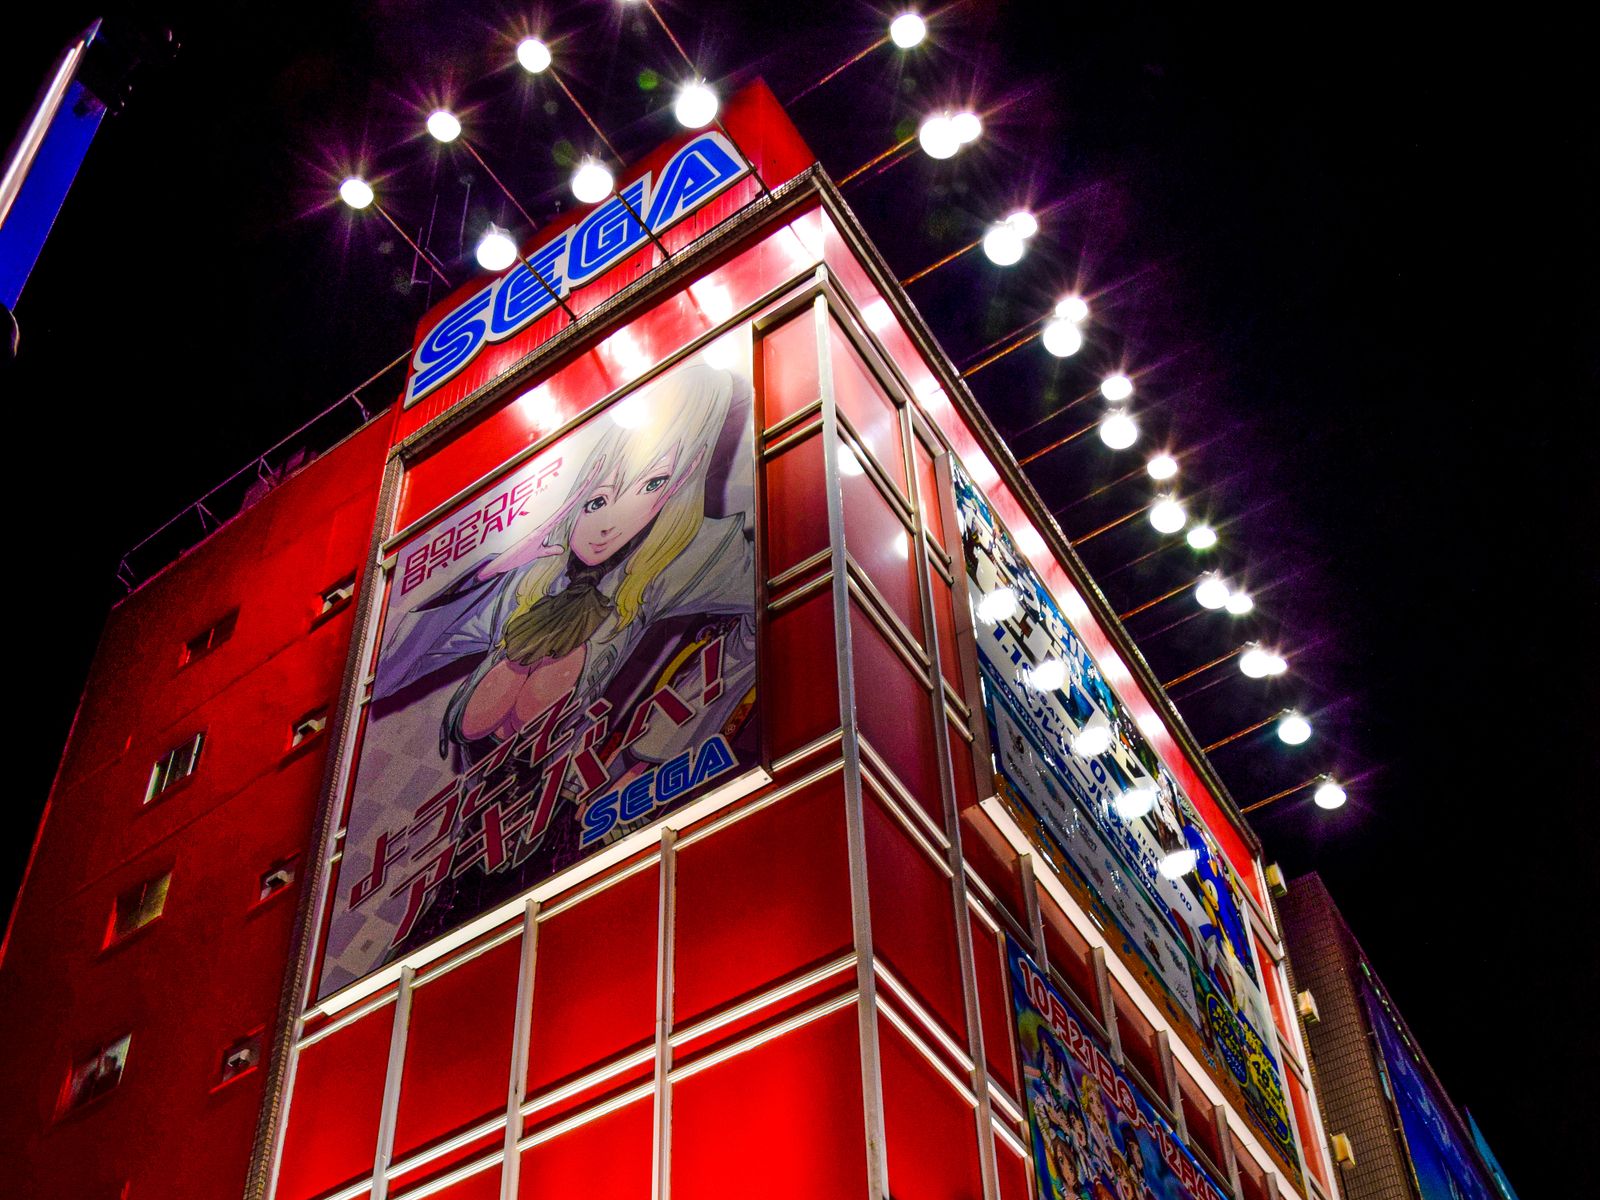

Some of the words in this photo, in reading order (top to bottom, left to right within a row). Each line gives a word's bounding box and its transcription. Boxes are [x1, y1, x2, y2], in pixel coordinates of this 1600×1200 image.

[406, 129, 748, 407] SEGA
[401, 497, 530, 595] BREAK
[405, 457, 563, 575] BORDER
[349, 688, 581, 910] ようこそ
[579, 735, 738, 849] SEGA
